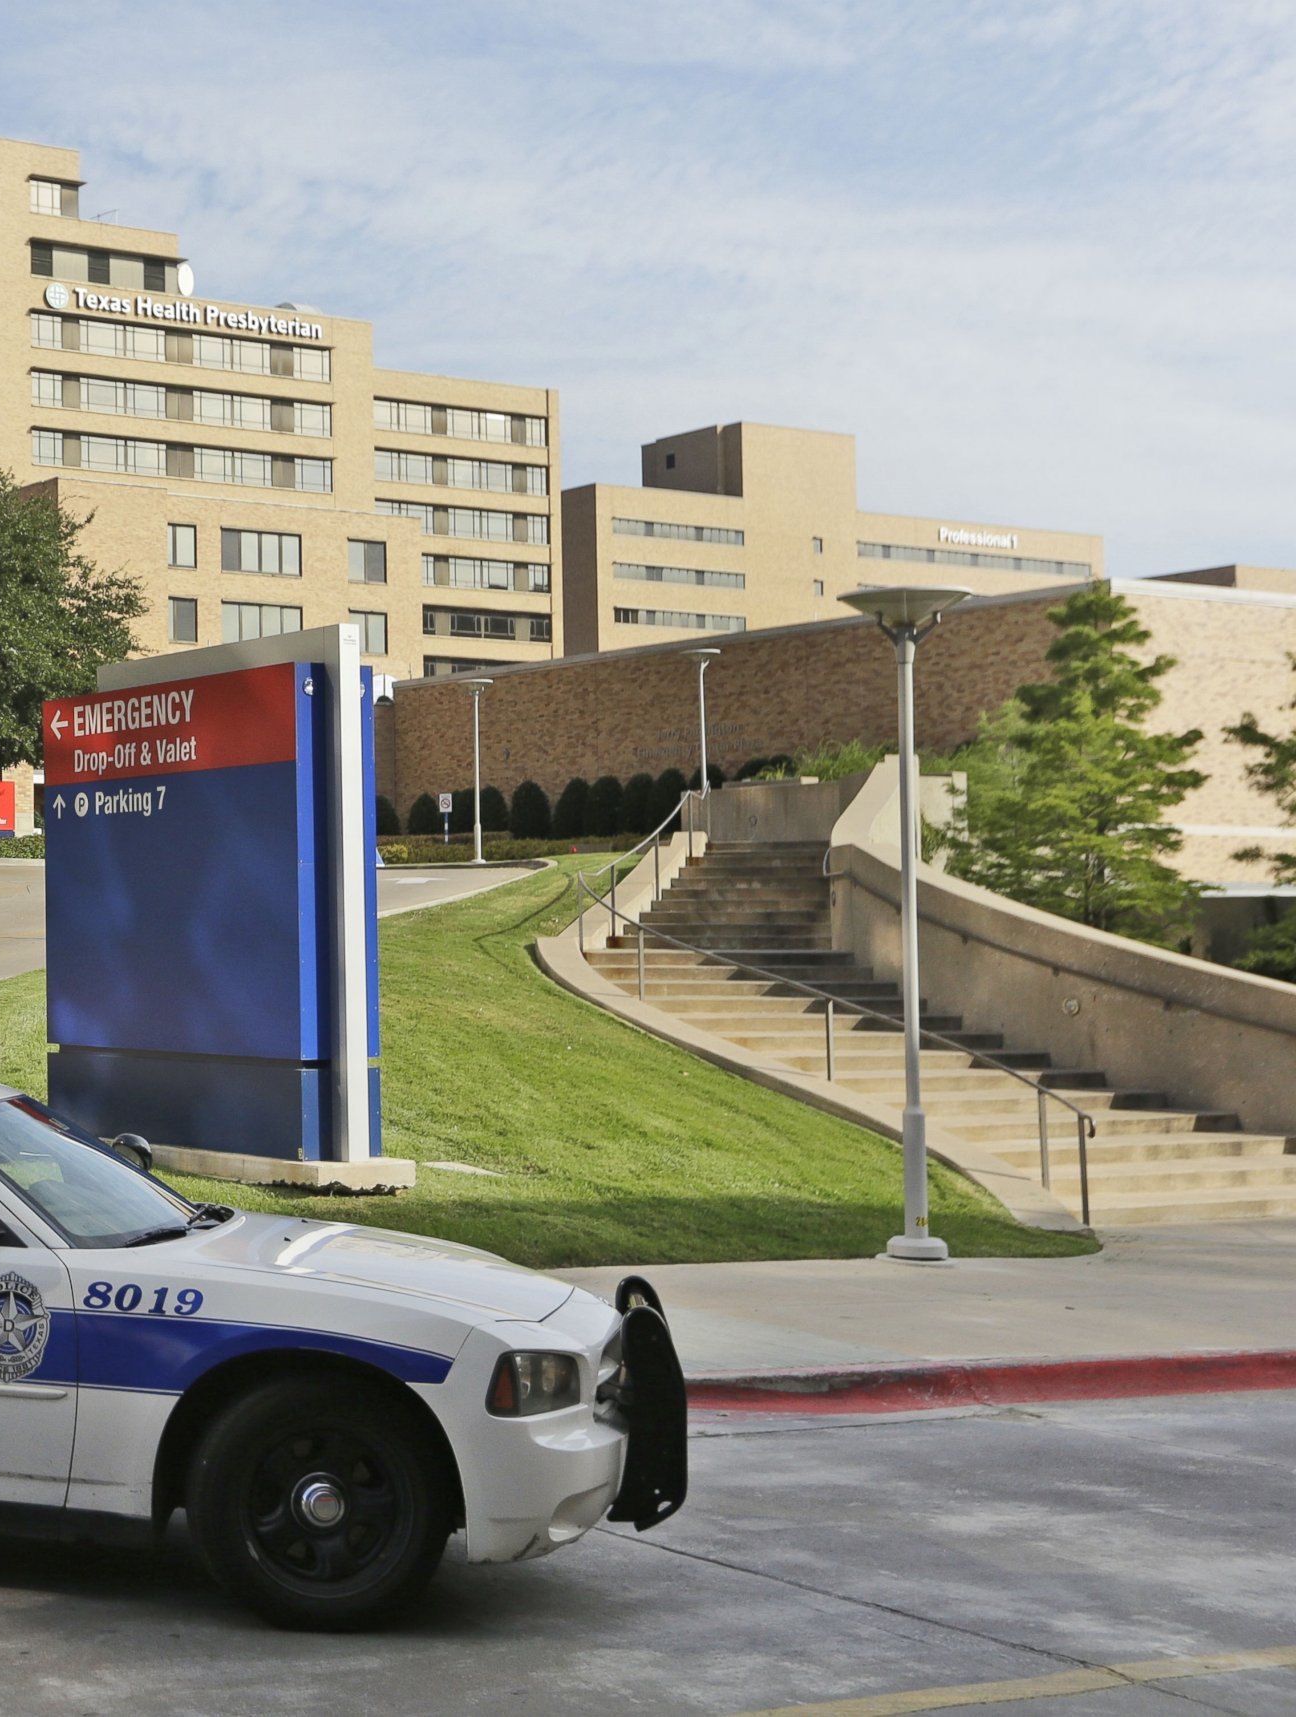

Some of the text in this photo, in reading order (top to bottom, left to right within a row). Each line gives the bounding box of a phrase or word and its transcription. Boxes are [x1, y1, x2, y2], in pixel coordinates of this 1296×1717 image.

[75, 287, 324, 340] Texas Health Presbyterian
[938, 526, 1012, 548] Professional
[73, 689, 194, 737] EMERGENCY
[74, 736, 197, 776] Drop-Off & Valet
[95, 788, 152, 817] Parking
[156, 785, 166, 810] 7
[83, 1281, 204, 1316] 8019
[3, 1319, 15, 1333] D
[28, 1323, 45, 1354] TEXAS
